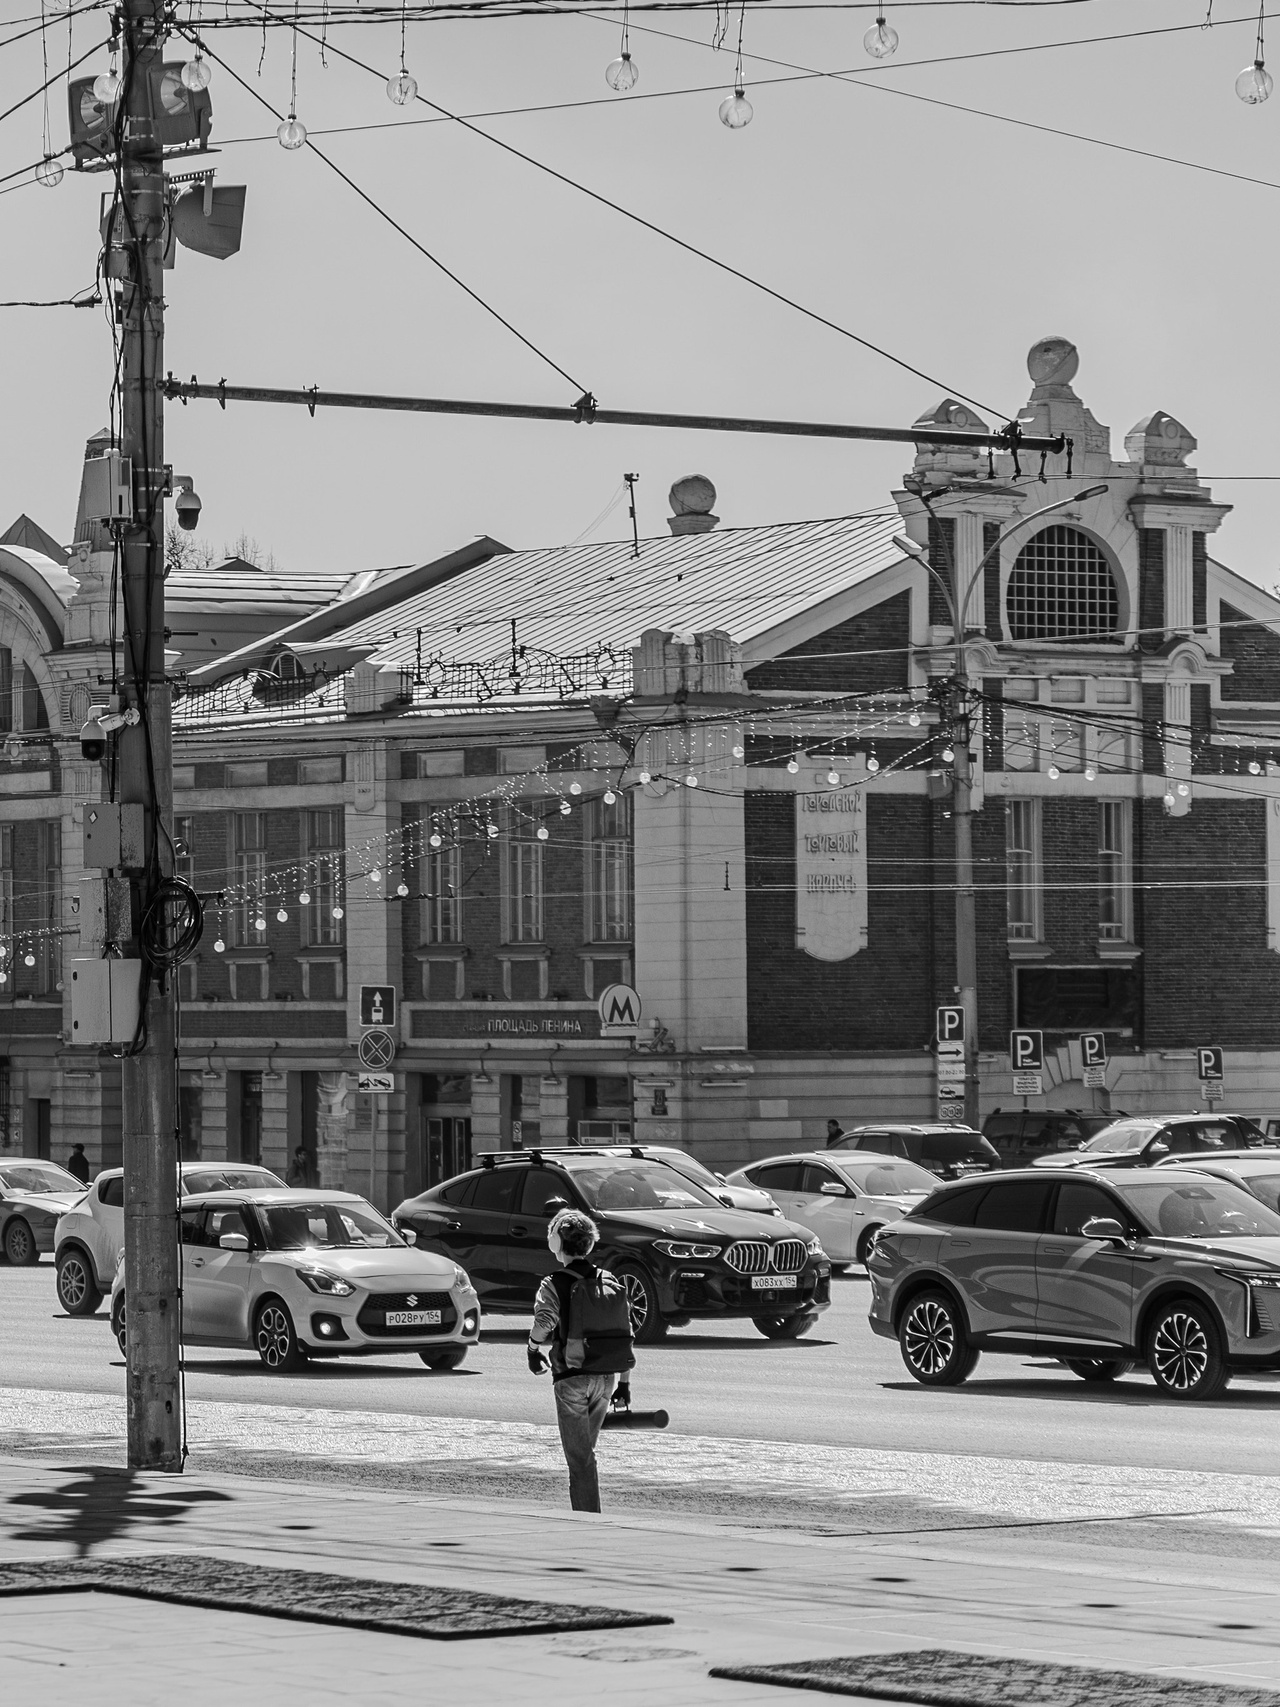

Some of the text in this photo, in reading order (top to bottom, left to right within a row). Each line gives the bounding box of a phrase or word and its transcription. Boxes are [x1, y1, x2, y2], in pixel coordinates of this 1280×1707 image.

[608, 995, 636, 1023] М
[488, 1019, 539, 1034] ПЛОЩАДЬ
[541, 1019, 582, 1033] ЛЕНИНА
[944, 1010, 960, 1039] P
[1016, 1035, 1034, 1067] P
[1085, 1036, 1099, 1064] P
[1201, 1050, 1215, 1077] P
[389, 1311, 440, 1324] Р028РУ 154
